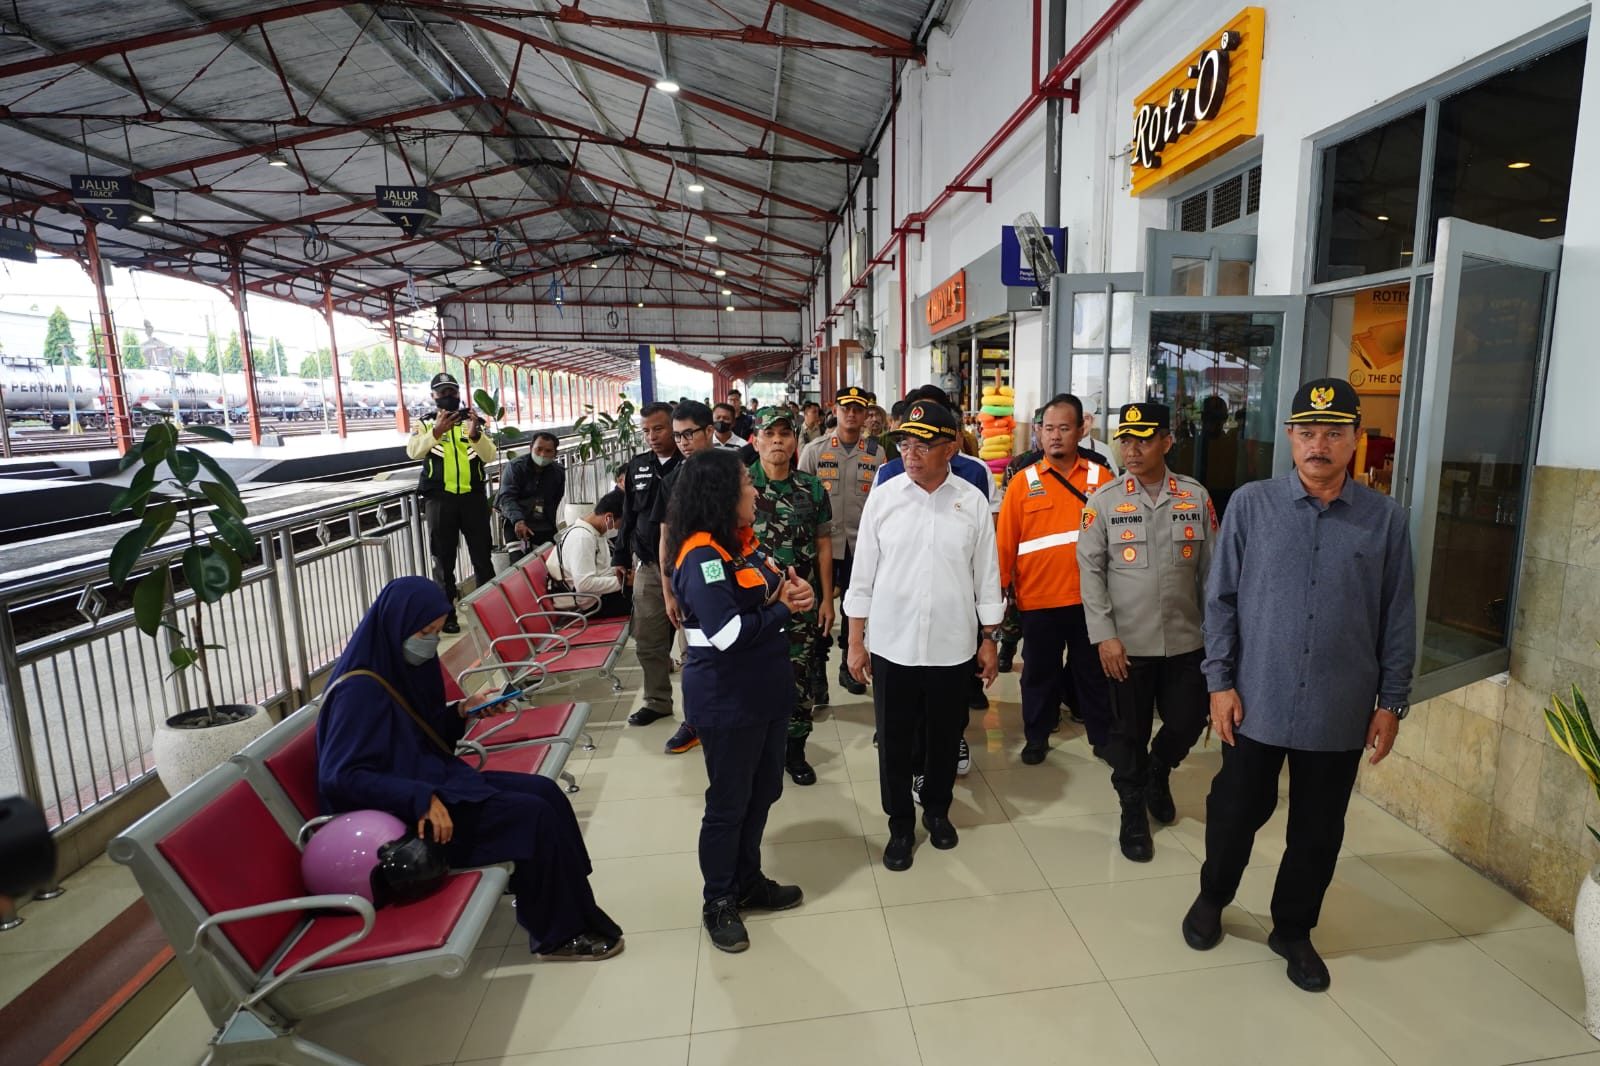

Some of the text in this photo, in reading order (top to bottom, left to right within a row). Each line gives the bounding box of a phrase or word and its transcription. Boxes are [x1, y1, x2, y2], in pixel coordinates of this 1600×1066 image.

[80, 180, 120, 191] JALUR
[90, 190, 113, 198] TRACK
[383, 190, 419, 200] JALUR
[101, 207, 118, 220] 2
[400, 215, 413, 227] 1
[1368, 374, 1387, 384] THE
[1389, 374, 1403, 384] DO
[817, 461, 839, 469] ANTON
[1172, 513, 1201, 522] POLRI
